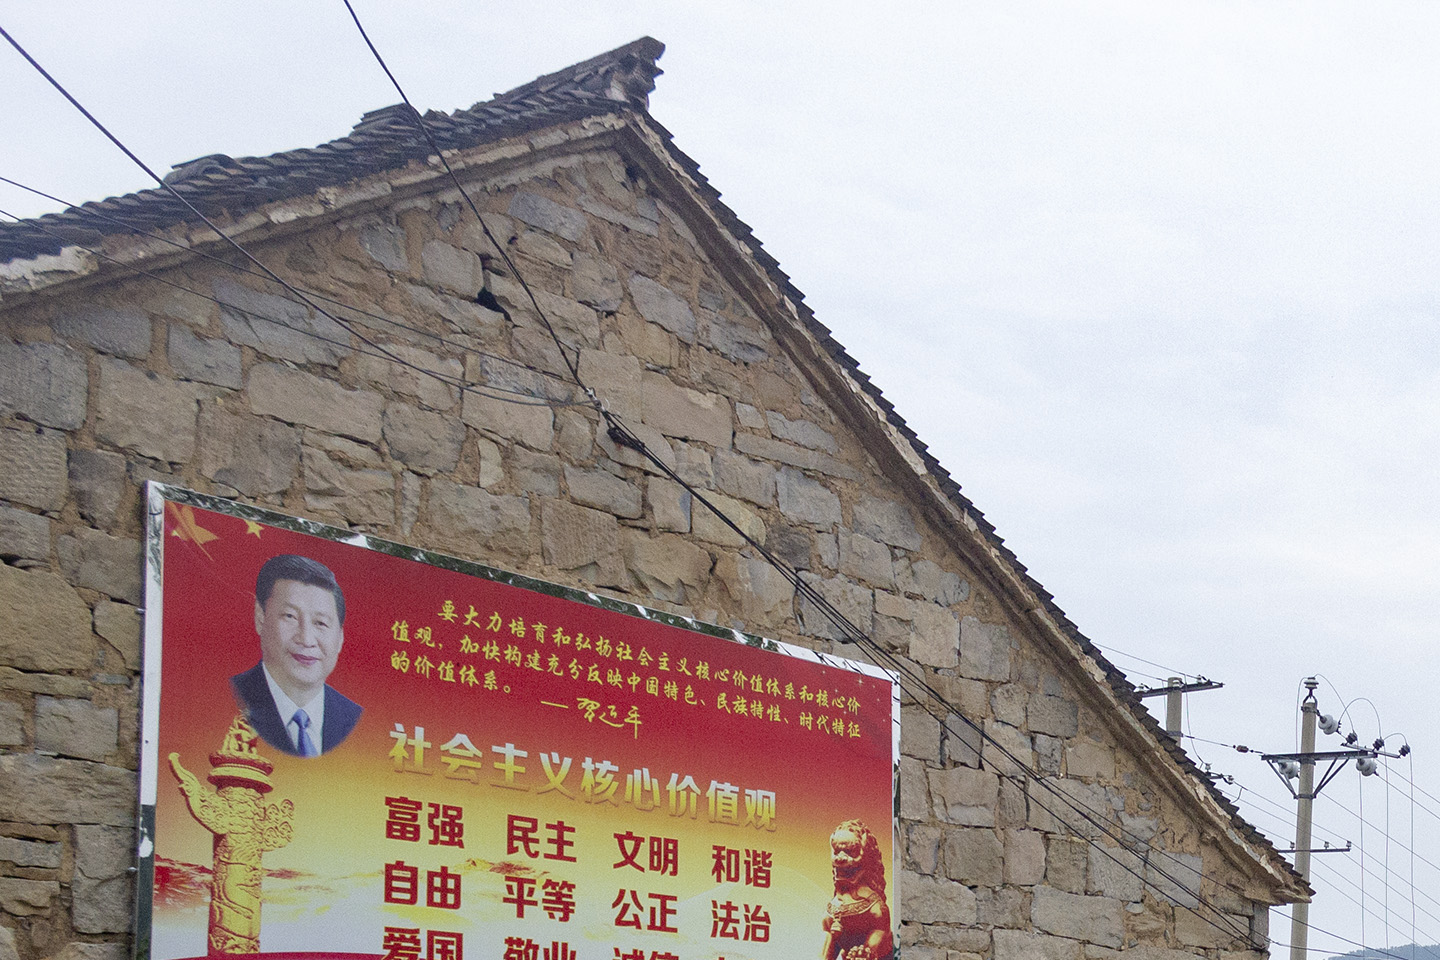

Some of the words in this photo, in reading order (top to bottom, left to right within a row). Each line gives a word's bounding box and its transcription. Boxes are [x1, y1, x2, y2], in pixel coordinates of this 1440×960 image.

[390, 650, 511, 694] 的价值体系。
[438, 600, 861, 715] 要大力培育和弘扬社会主义核心价值体系和核心价
[385, 722, 778, 832] 社会主义核心价值观
[384, 796, 465, 850] 富强
[506, 813, 578, 863] 民主
[612, 830, 679, 877] 文明
[711, 845, 773, 889] 和谐
[383, 860, 462, 910] 自由
[503, 875, 577, 923] 平等
[611, 888, 679, 934] 公正
[710, 900, 772, 943] 法治
